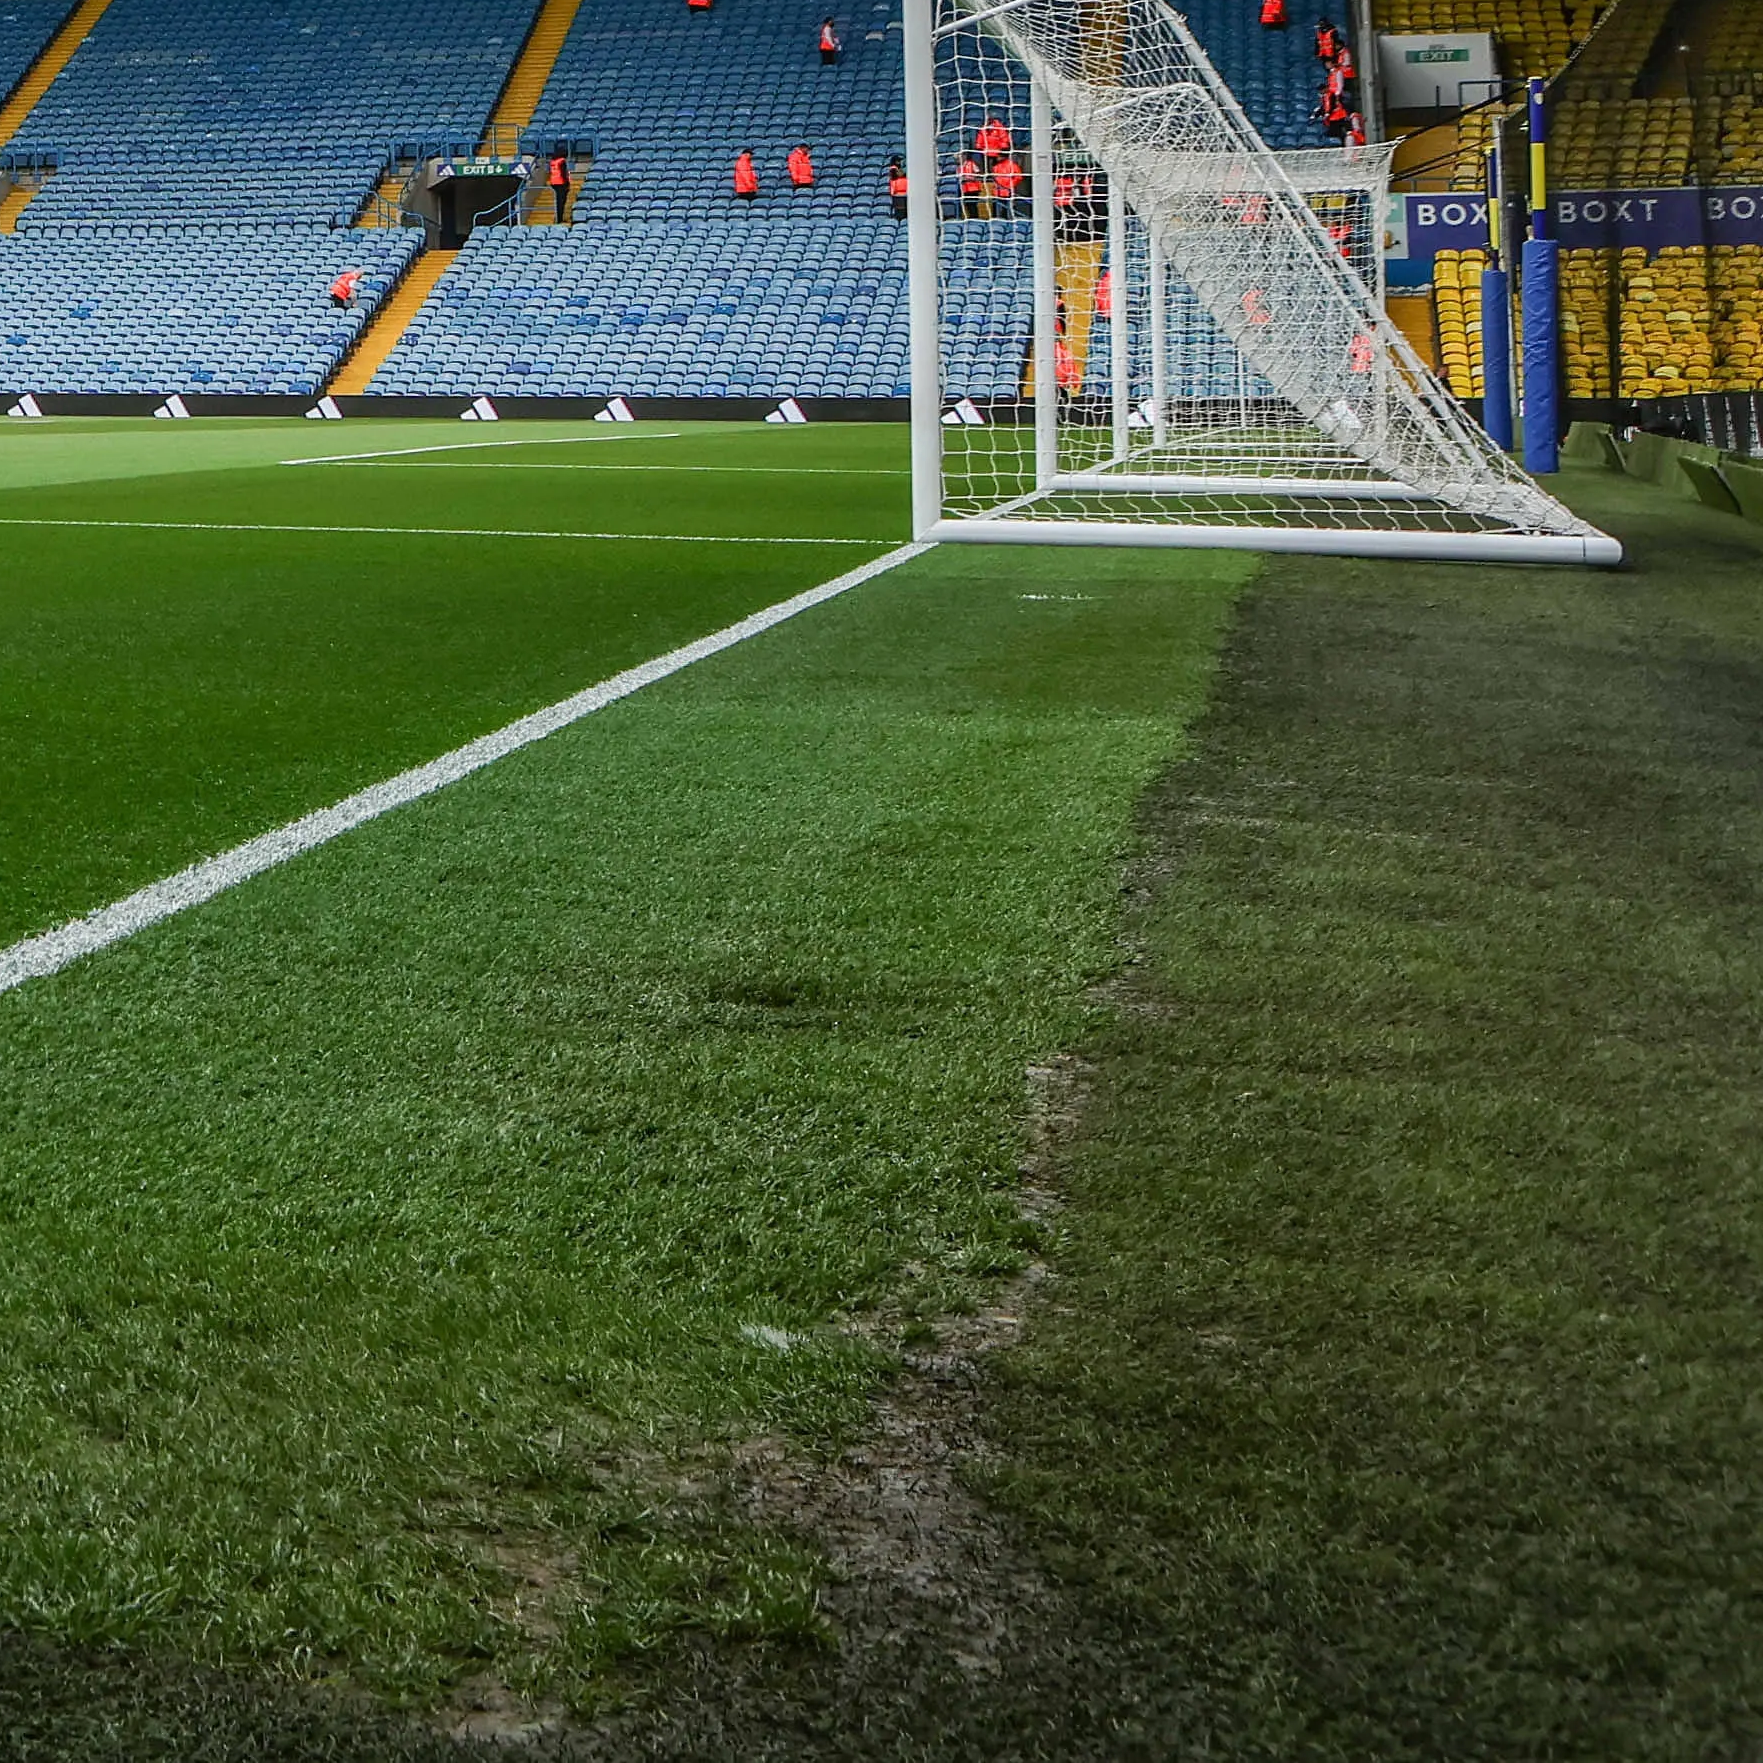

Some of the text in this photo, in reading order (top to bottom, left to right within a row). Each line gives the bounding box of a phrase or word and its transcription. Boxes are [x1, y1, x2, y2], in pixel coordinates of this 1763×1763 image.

[463, 166, 486, 175] EXIT
[1417, 203, 1487, 226] BOX
[1558, 200, 1658, 223] BOXT
[1707, 196, 1763, 221] BO
